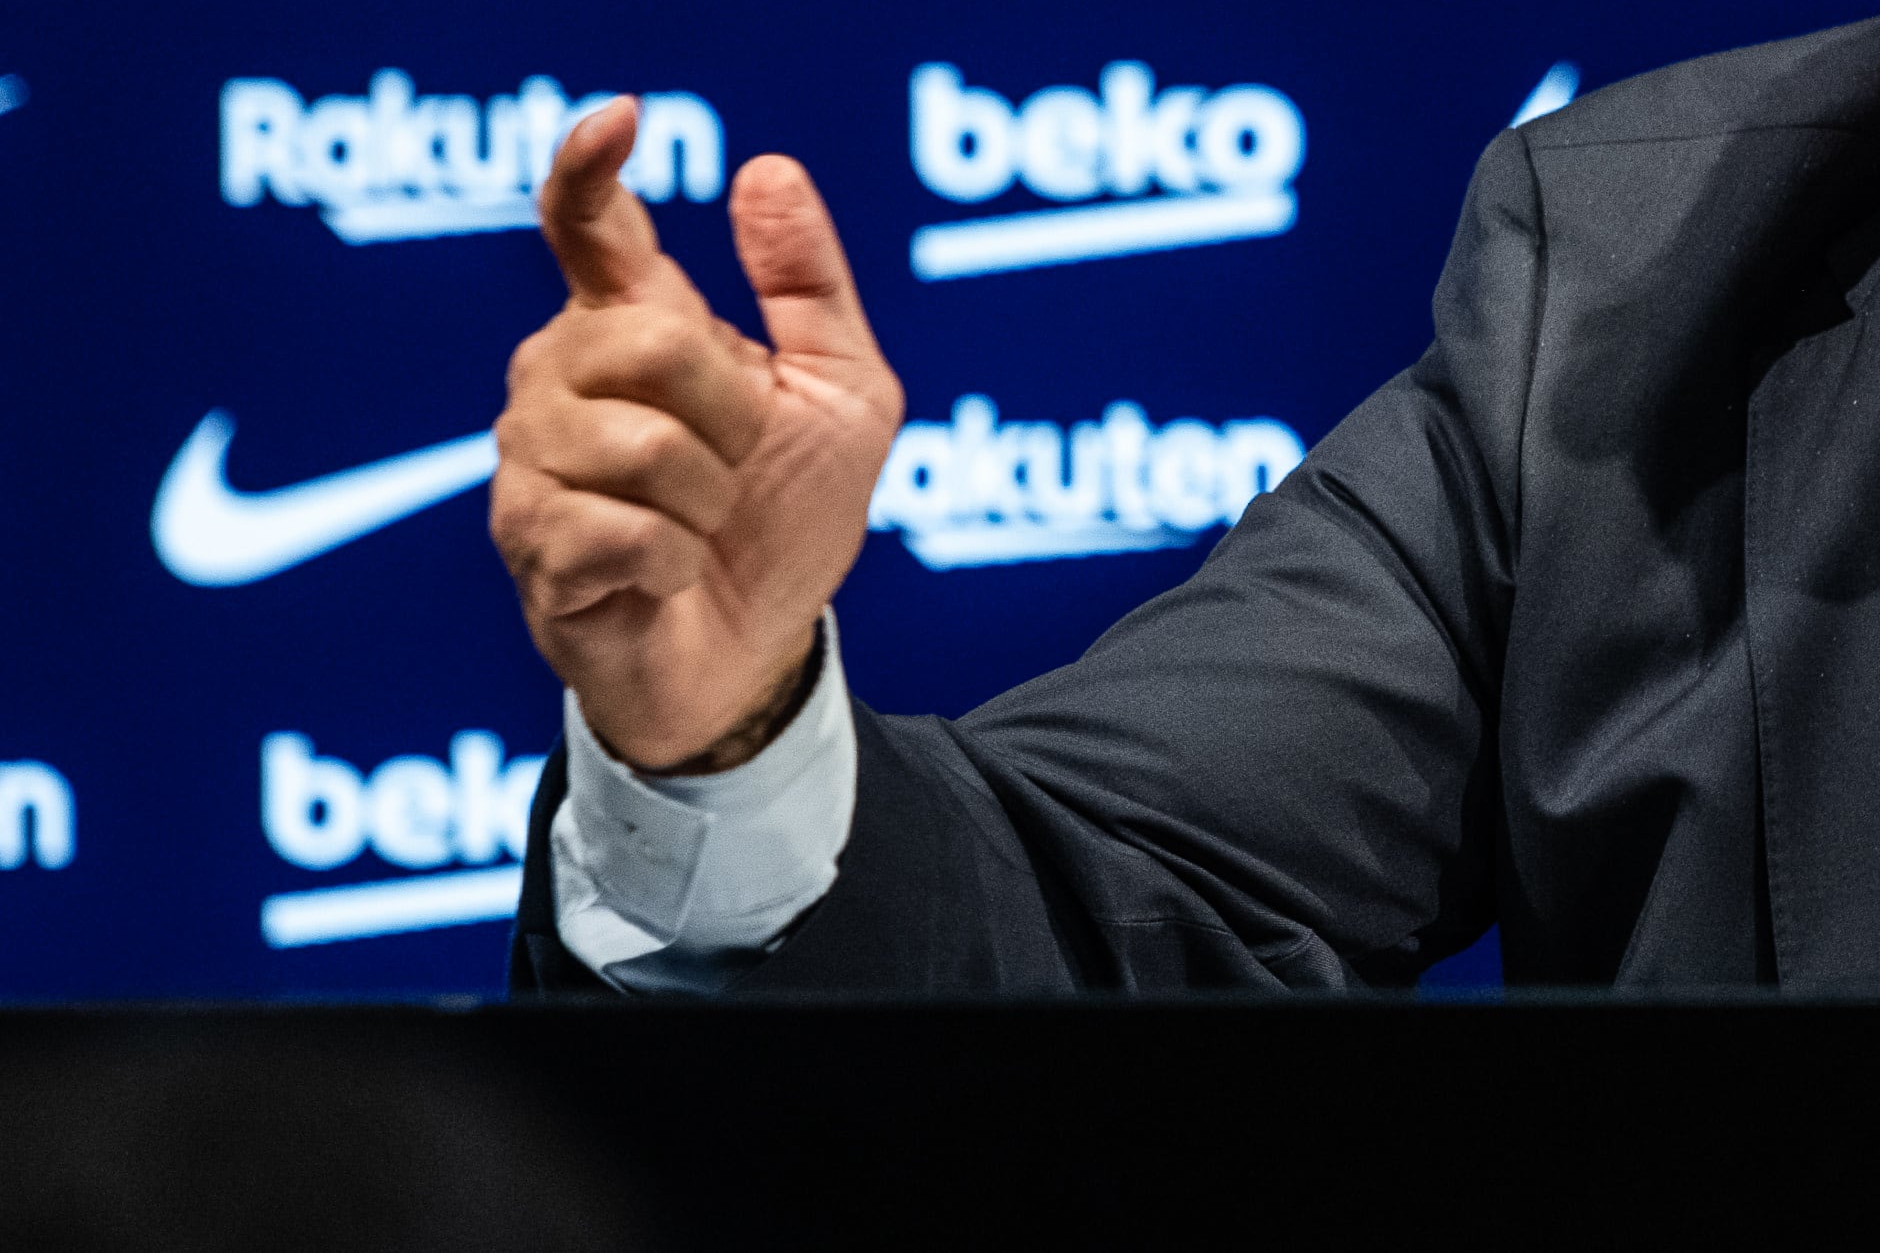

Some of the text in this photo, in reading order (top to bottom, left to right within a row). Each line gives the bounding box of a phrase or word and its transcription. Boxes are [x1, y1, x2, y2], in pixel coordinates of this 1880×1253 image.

[220, 67, 727, 207] Rakutn
[909, 61, 1306, 202] beko
[868, 394, 1308, 532] akuten
